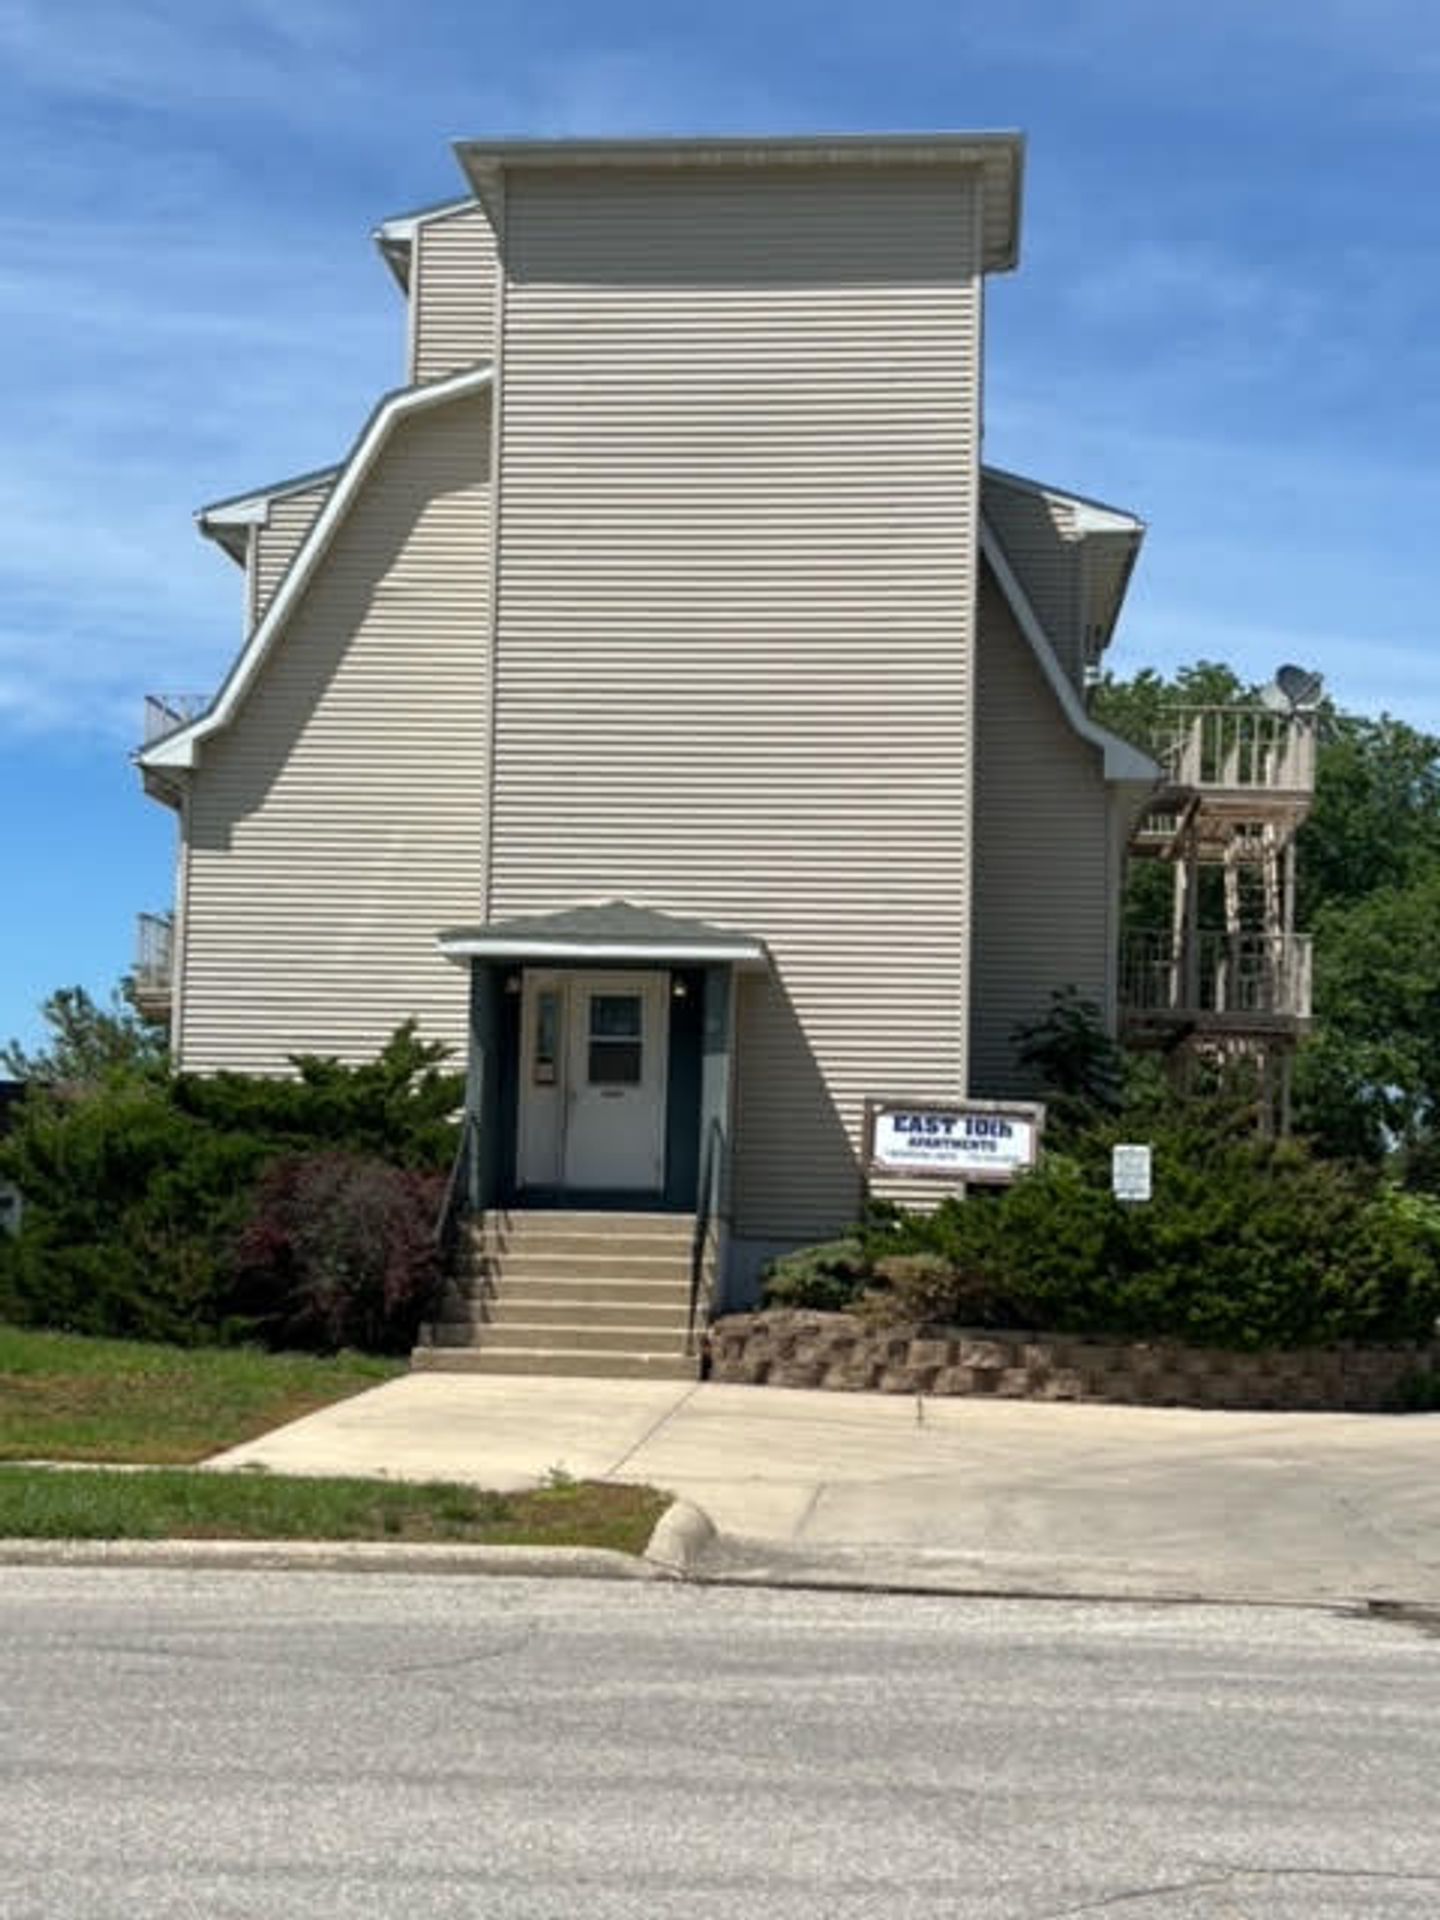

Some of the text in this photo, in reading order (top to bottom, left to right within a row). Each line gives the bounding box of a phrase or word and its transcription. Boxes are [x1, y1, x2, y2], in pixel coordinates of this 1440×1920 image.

[893, 1115, 1013, 1138] EAST 10th
[908, 1137, 997, 1152] APARTMENTS
